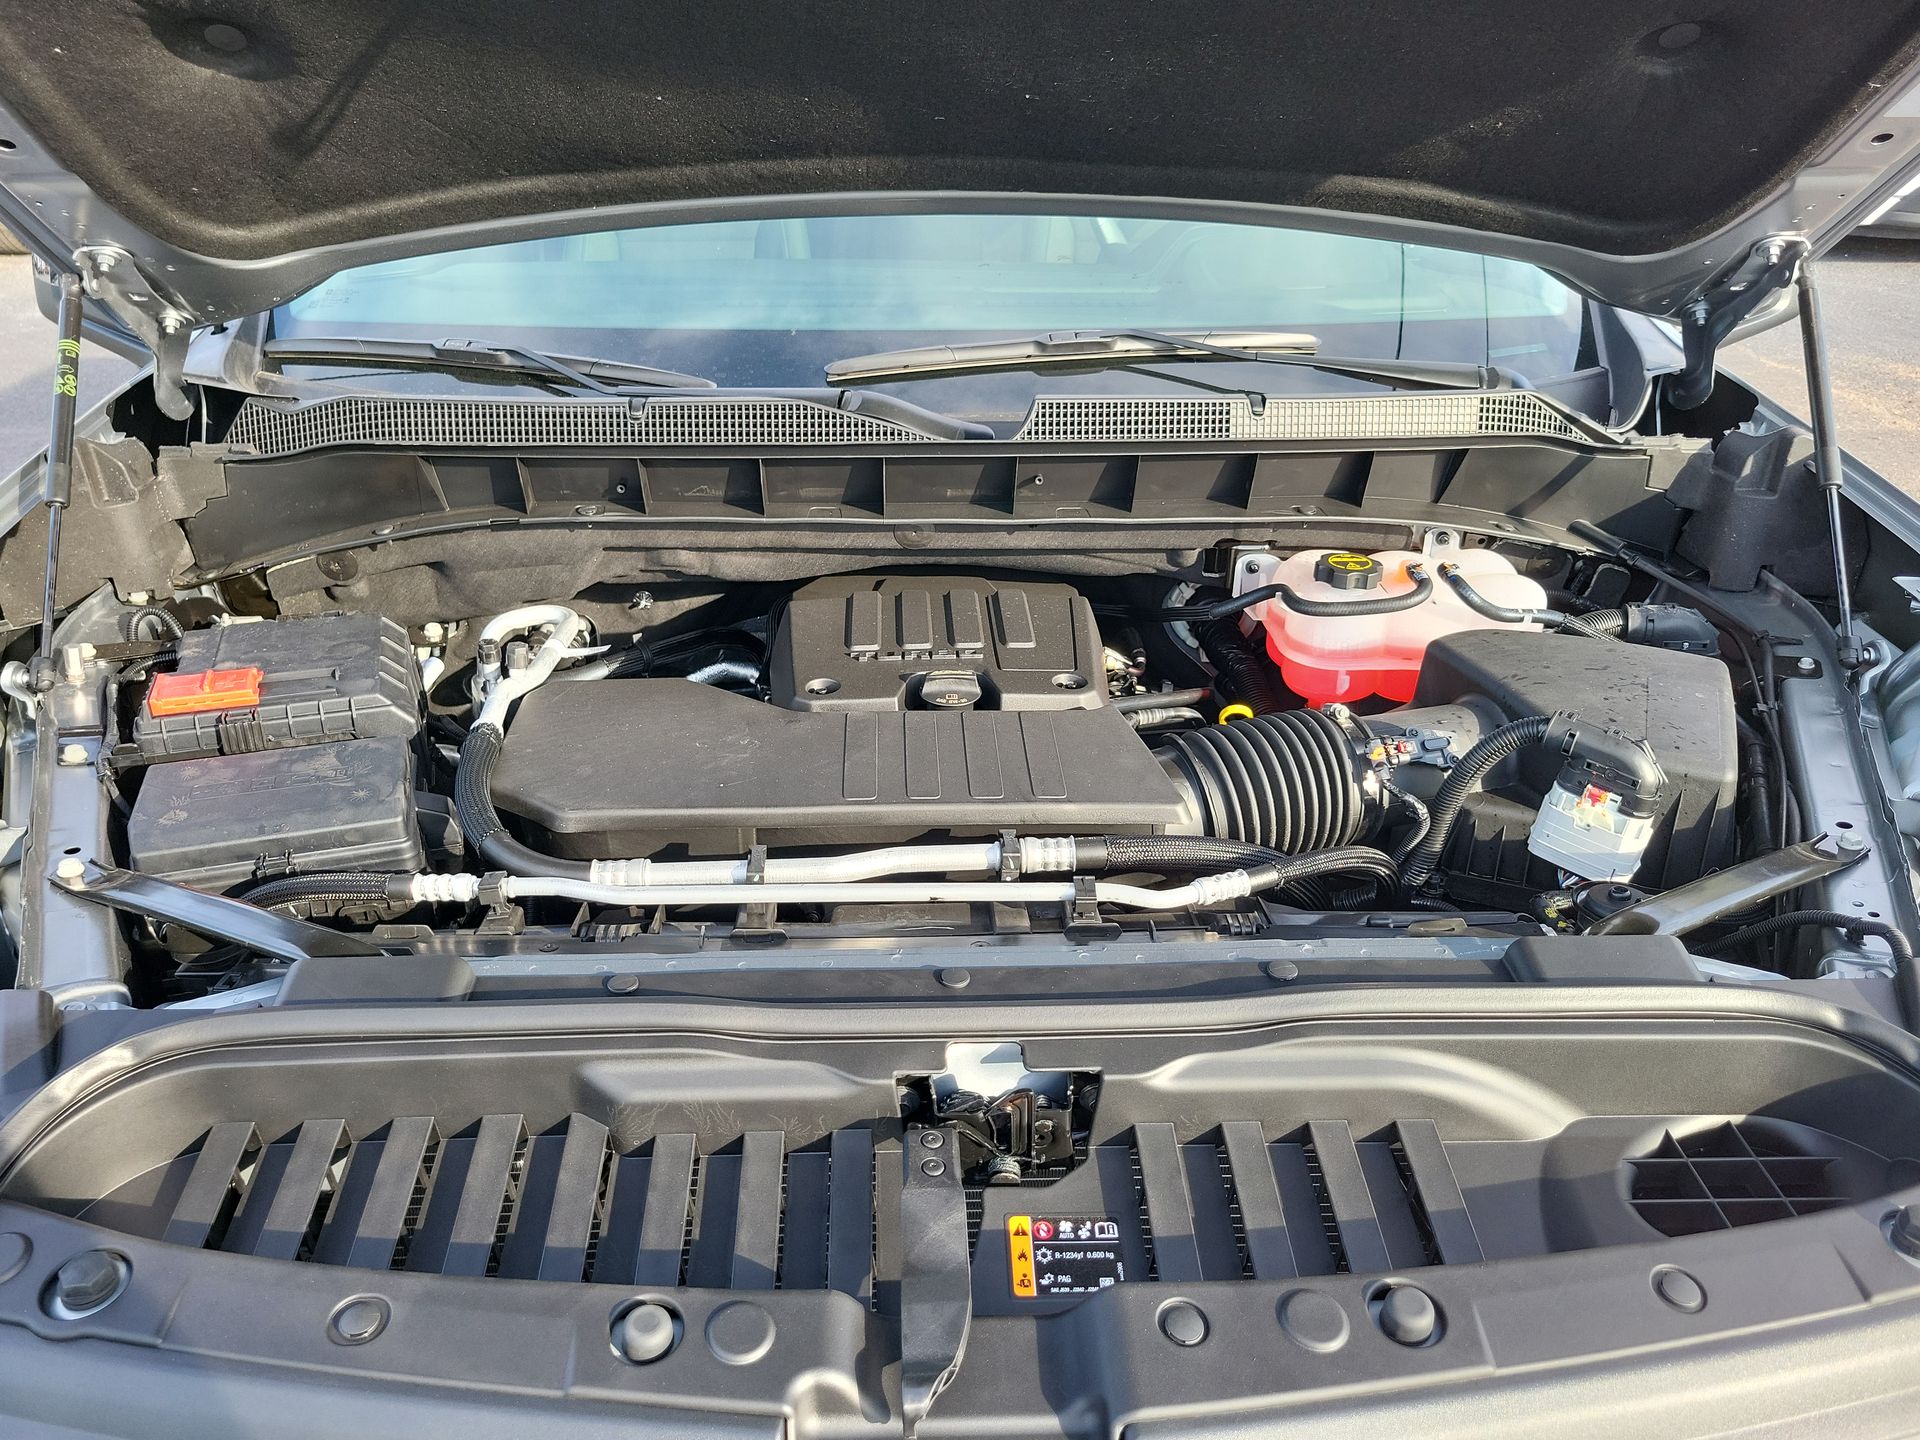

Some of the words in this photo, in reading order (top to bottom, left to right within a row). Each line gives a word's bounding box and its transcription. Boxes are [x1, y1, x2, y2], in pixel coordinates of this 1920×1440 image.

[1055, 1251, 1084, 1260] R-1234yf
[1086, 1251, 1105, 1259] 0.600
[1105, 1250, 1115, 1260] kg
[1057, 1275, 1072, 1283] PAG
